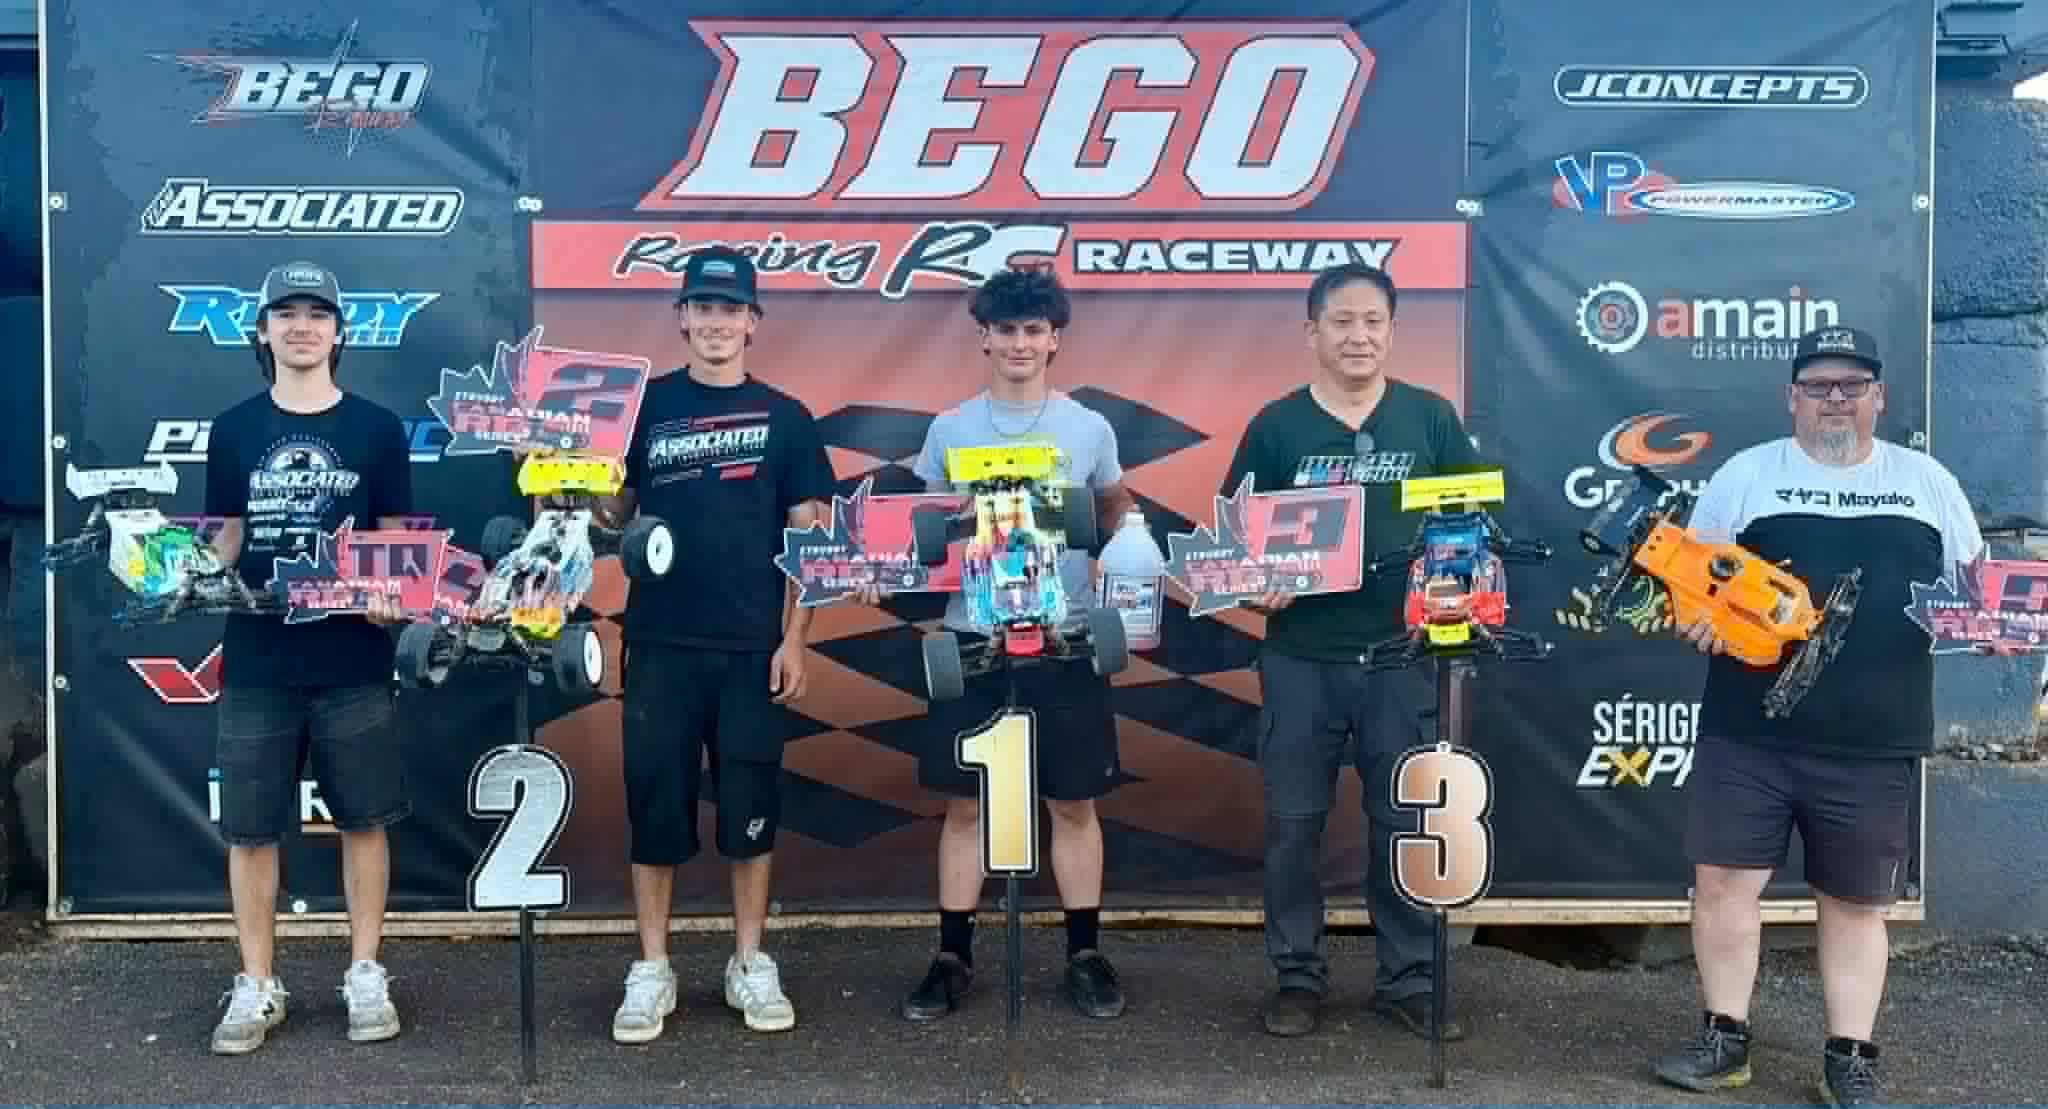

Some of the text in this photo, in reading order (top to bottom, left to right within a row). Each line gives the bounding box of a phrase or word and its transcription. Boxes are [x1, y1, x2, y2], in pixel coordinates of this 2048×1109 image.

[226, 63, 428, 111] BEGO
[664, 33, 1362, 200] BEGO
[1564, 72, 1858, 101] JCONCEPTS
[1554, 152, 1648, 215] VP
[1075, 239, 1400, 273] RACEWAY
[1657, 285, 1840, 339] amain
[958, 710, 1034, 873] 1
[470, 746, 570, 910] 2
[1393, 748, 1492, 907] 3
